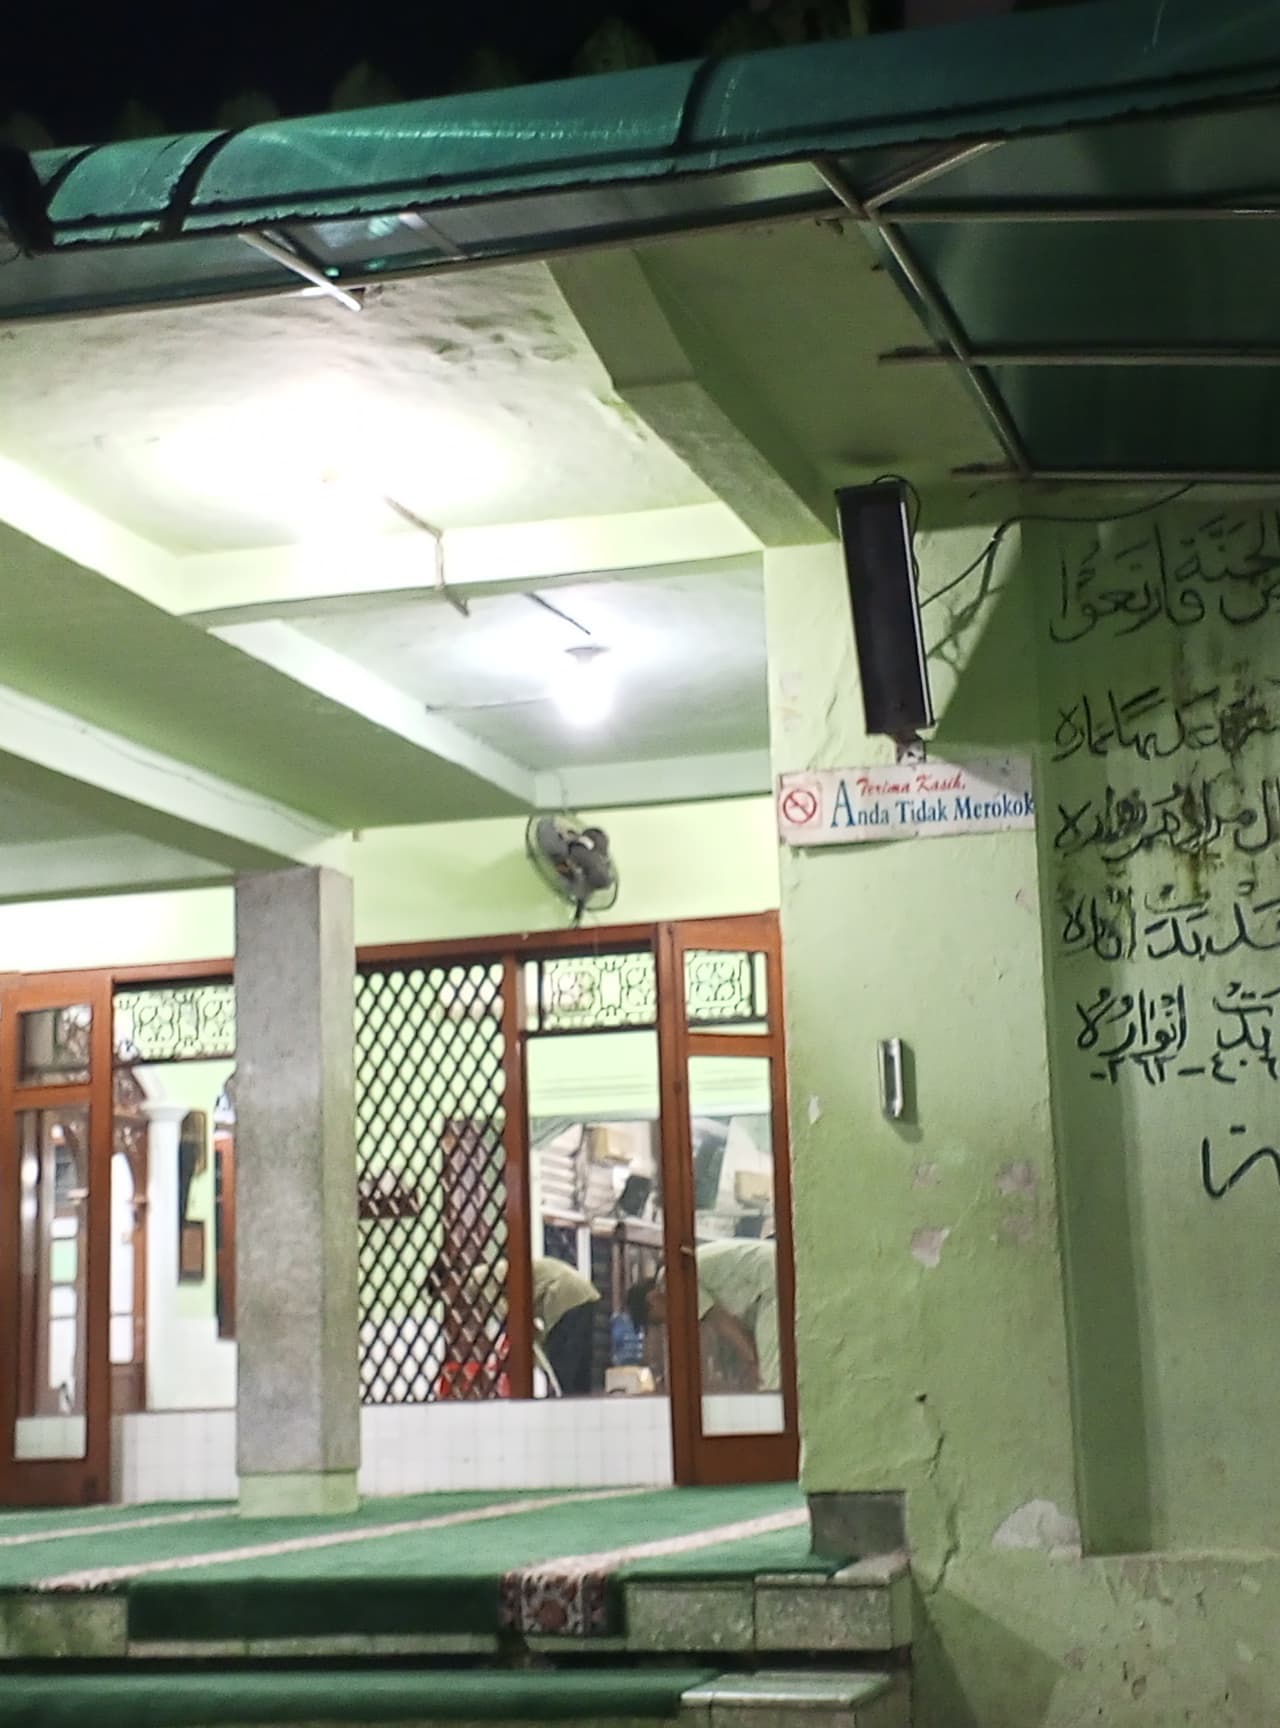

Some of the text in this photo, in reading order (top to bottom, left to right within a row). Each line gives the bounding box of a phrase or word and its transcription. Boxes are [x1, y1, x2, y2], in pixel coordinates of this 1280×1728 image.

[830, 778, 1035, 828] Anda Tidak Merokok
[856, 776, 911, 797] Terima
